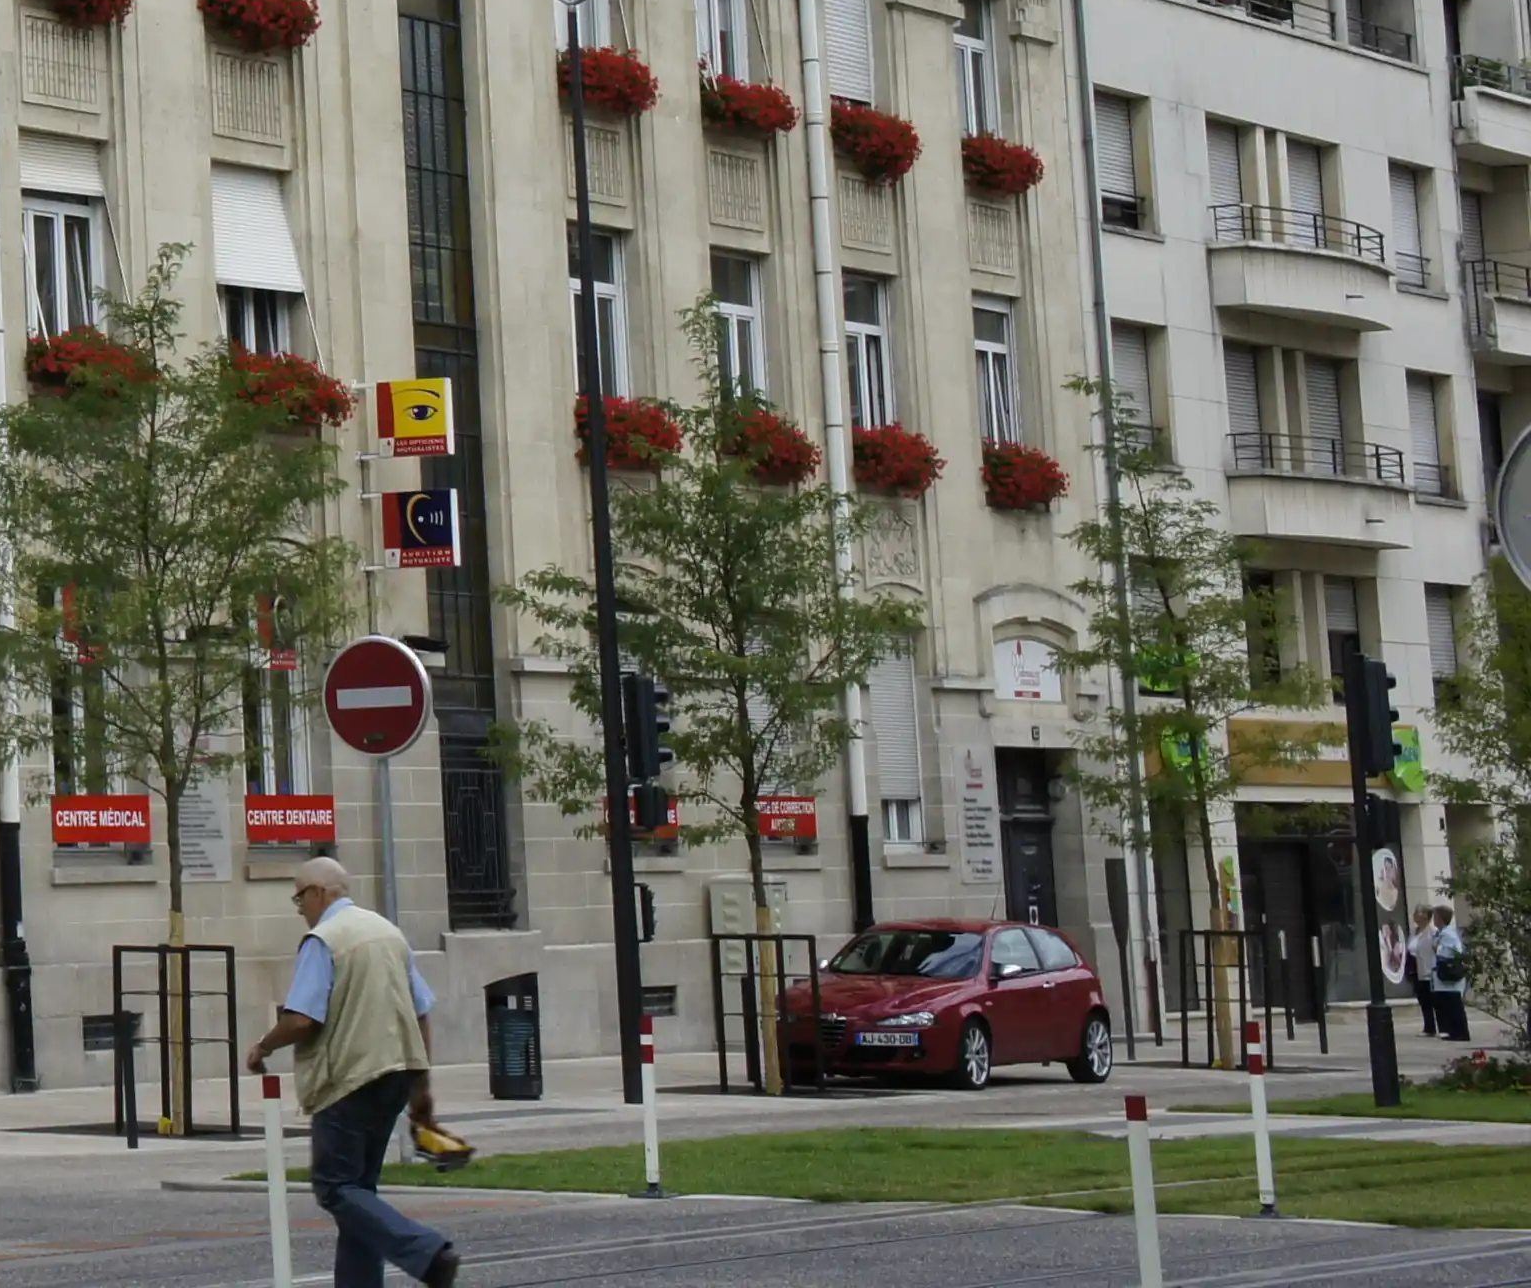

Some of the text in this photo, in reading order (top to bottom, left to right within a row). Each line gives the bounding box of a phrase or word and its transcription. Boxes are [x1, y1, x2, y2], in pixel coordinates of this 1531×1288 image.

[56, 807, 146, 827] CENTRE MÉDICAL
[247, 809, 332, 825] CENTRE DENTAIRE
